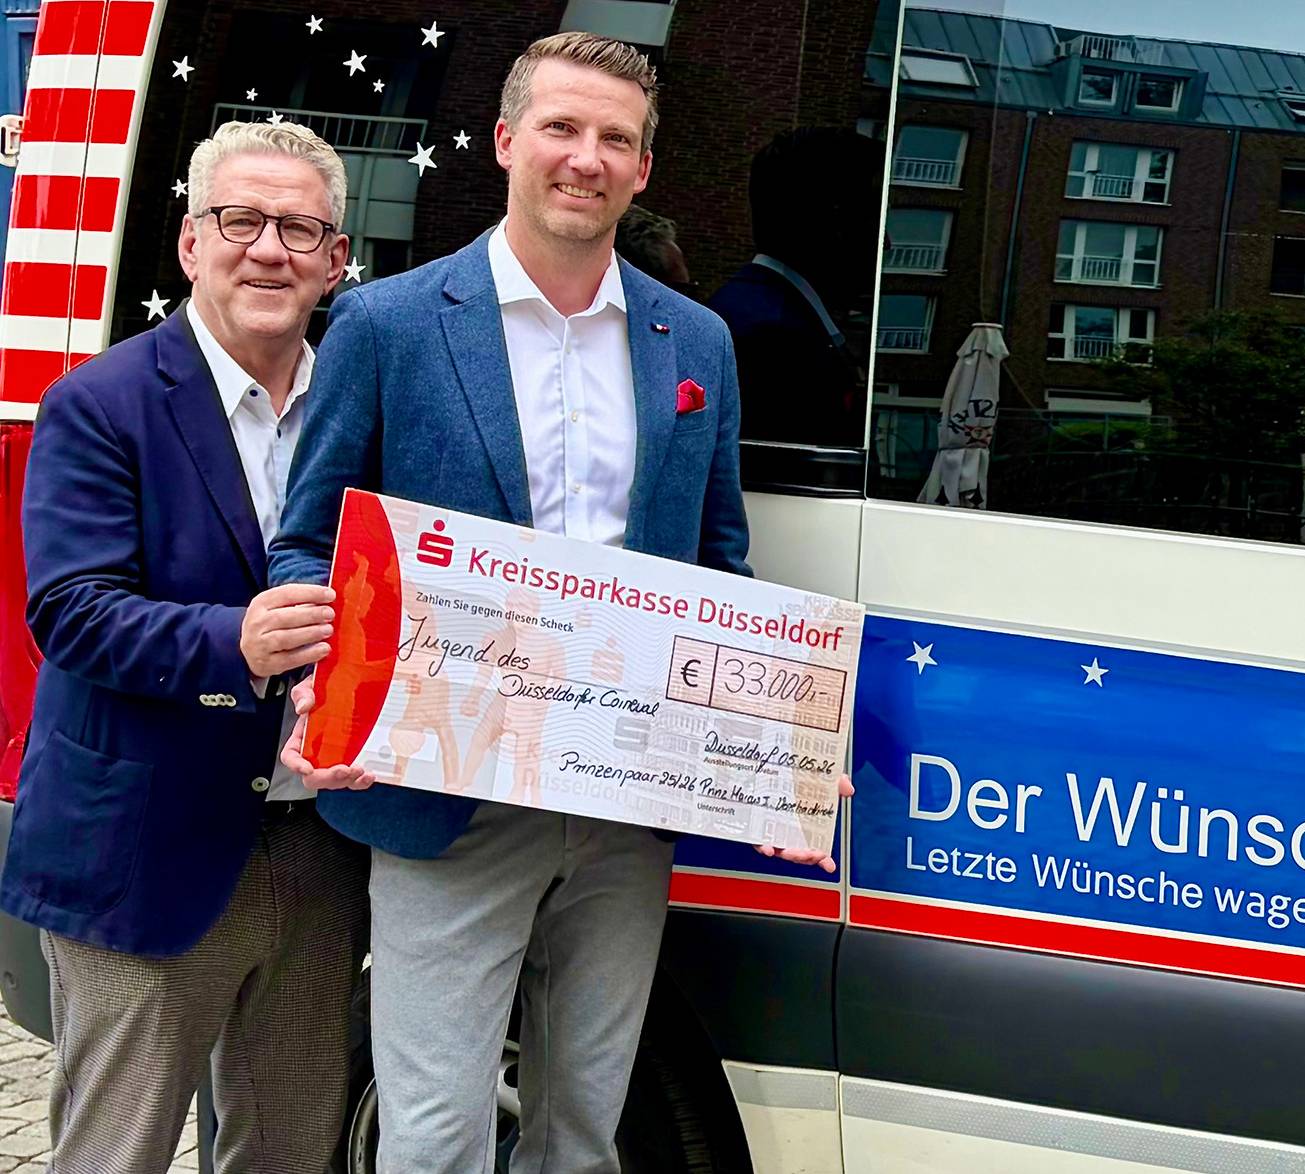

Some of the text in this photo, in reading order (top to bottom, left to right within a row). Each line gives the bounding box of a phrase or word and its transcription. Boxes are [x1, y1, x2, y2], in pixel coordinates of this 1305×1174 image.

[415, 591, 575, 633] Zahlen Sie gegen diesen Scheck
[468, 547, 689, 619] Kreissparkasse
[697, 597, 844, 650] Düsseldorf
[398, 614, 531, 677] Jugend des
[497, 674, 596, 710] Düsseldorfer
[680, 659, 701, 688] €
[724, 658, 829, 702] 33.000,-
[703, 757, 754, 771] Ausstellungsort
[704, 730, 835, 775] Düsseldorf 05.05.26
[559, 751, 659, 787] Prinzenpaar
[659, 772, 698, 791] 25/26
[700, 778, 728, 800] Prinz
[909, 753, 1043, 833] Der
[697, 803, 735, 815] Unterschrift
[906, 836, 1017, 883] Letzte
[1032, 853, 1203, 909] Wünsche
